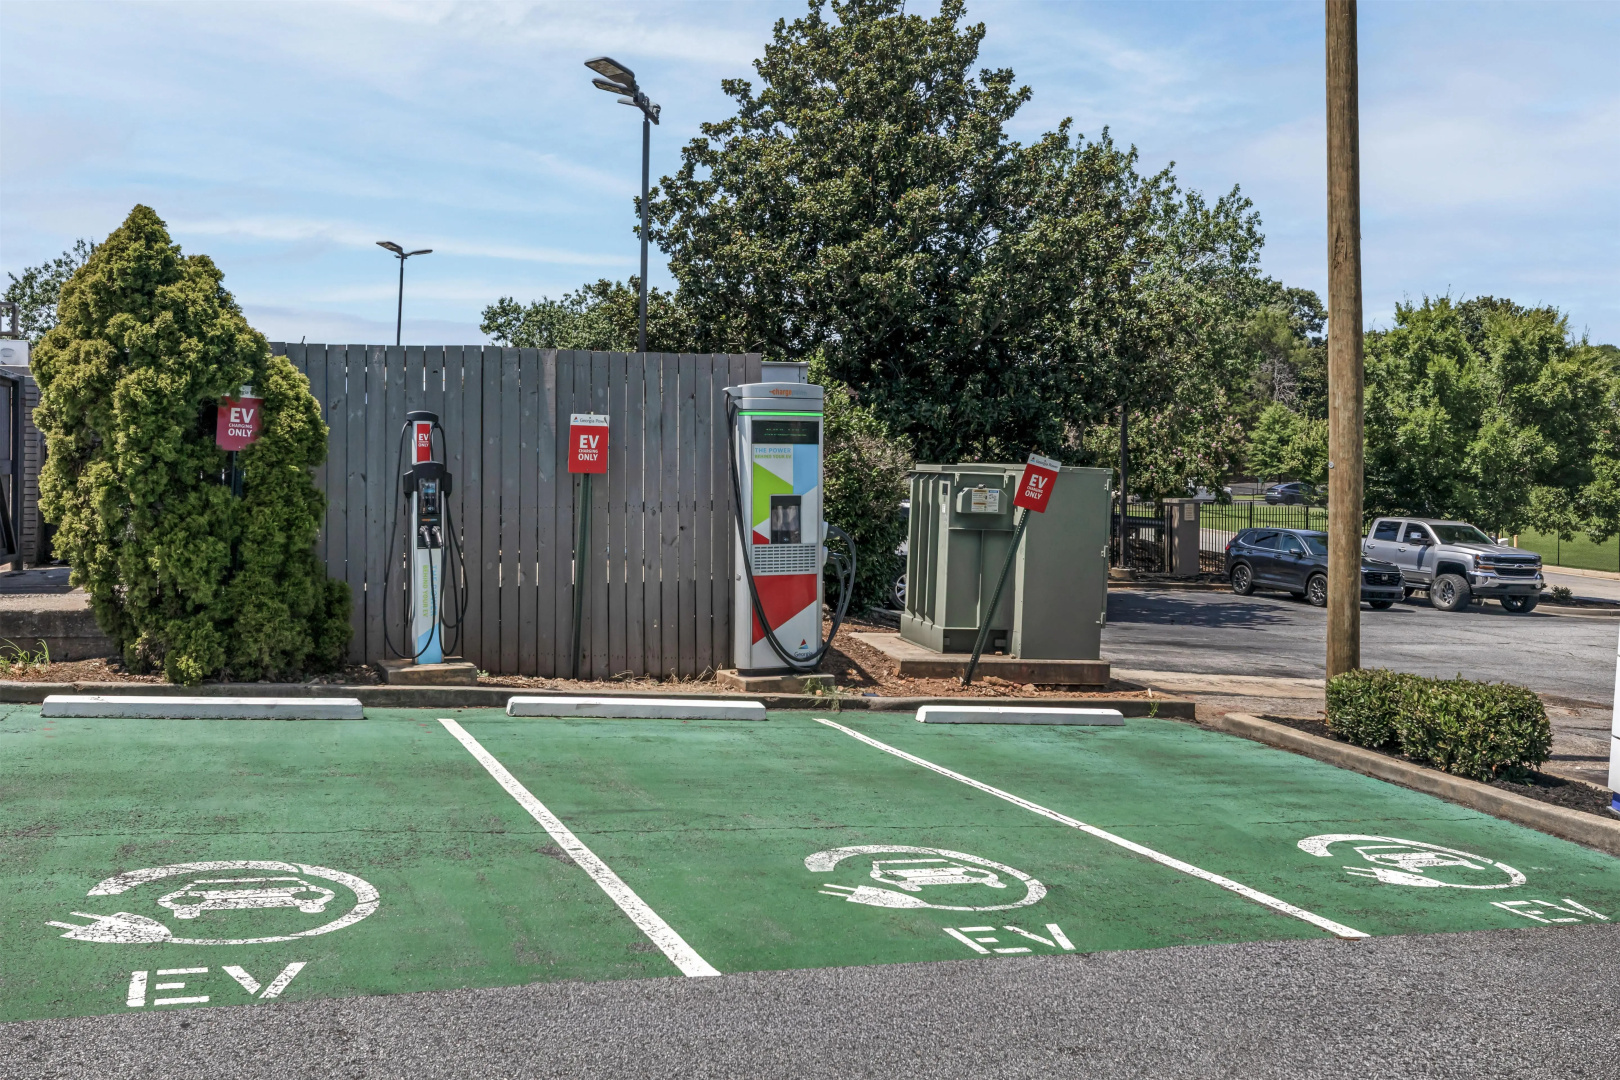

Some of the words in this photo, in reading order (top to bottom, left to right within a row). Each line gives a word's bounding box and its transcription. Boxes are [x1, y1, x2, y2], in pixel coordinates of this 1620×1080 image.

[230, 407, 254, 423] EV
[228, 428, 252, 437] ONLY
[580, 434, 599, 448] EV
[1029, 474, 1048, 488] EV
[1024, 490, 1042, 500] ONLY
[422, 609, 428, 618] EV
[1489, 899, 1611, 923] EV
[942, 923, 1076, 954] EV
[126, 961, 307, 1007] EV
